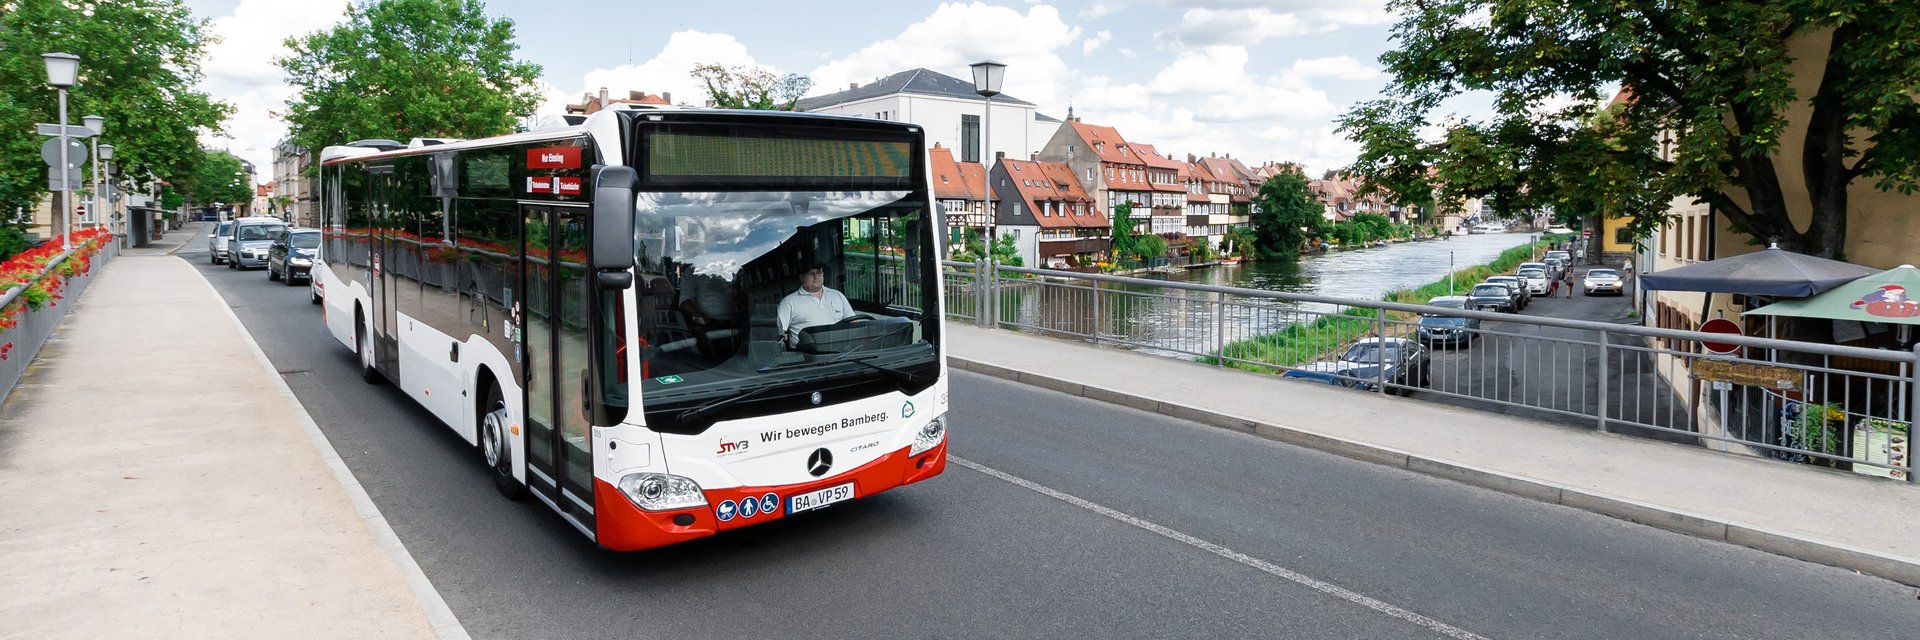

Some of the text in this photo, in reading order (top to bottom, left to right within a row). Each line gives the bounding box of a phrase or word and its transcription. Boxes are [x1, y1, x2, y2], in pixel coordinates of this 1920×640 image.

[760, 412, 889, 443] Wir bewegen Bamberg.
[850, 441, 879, 453] CITARO
[795, 495, 811, 510] BA
[818, 490, 833, 504] VP
[835, 485, 848, 500] 59
